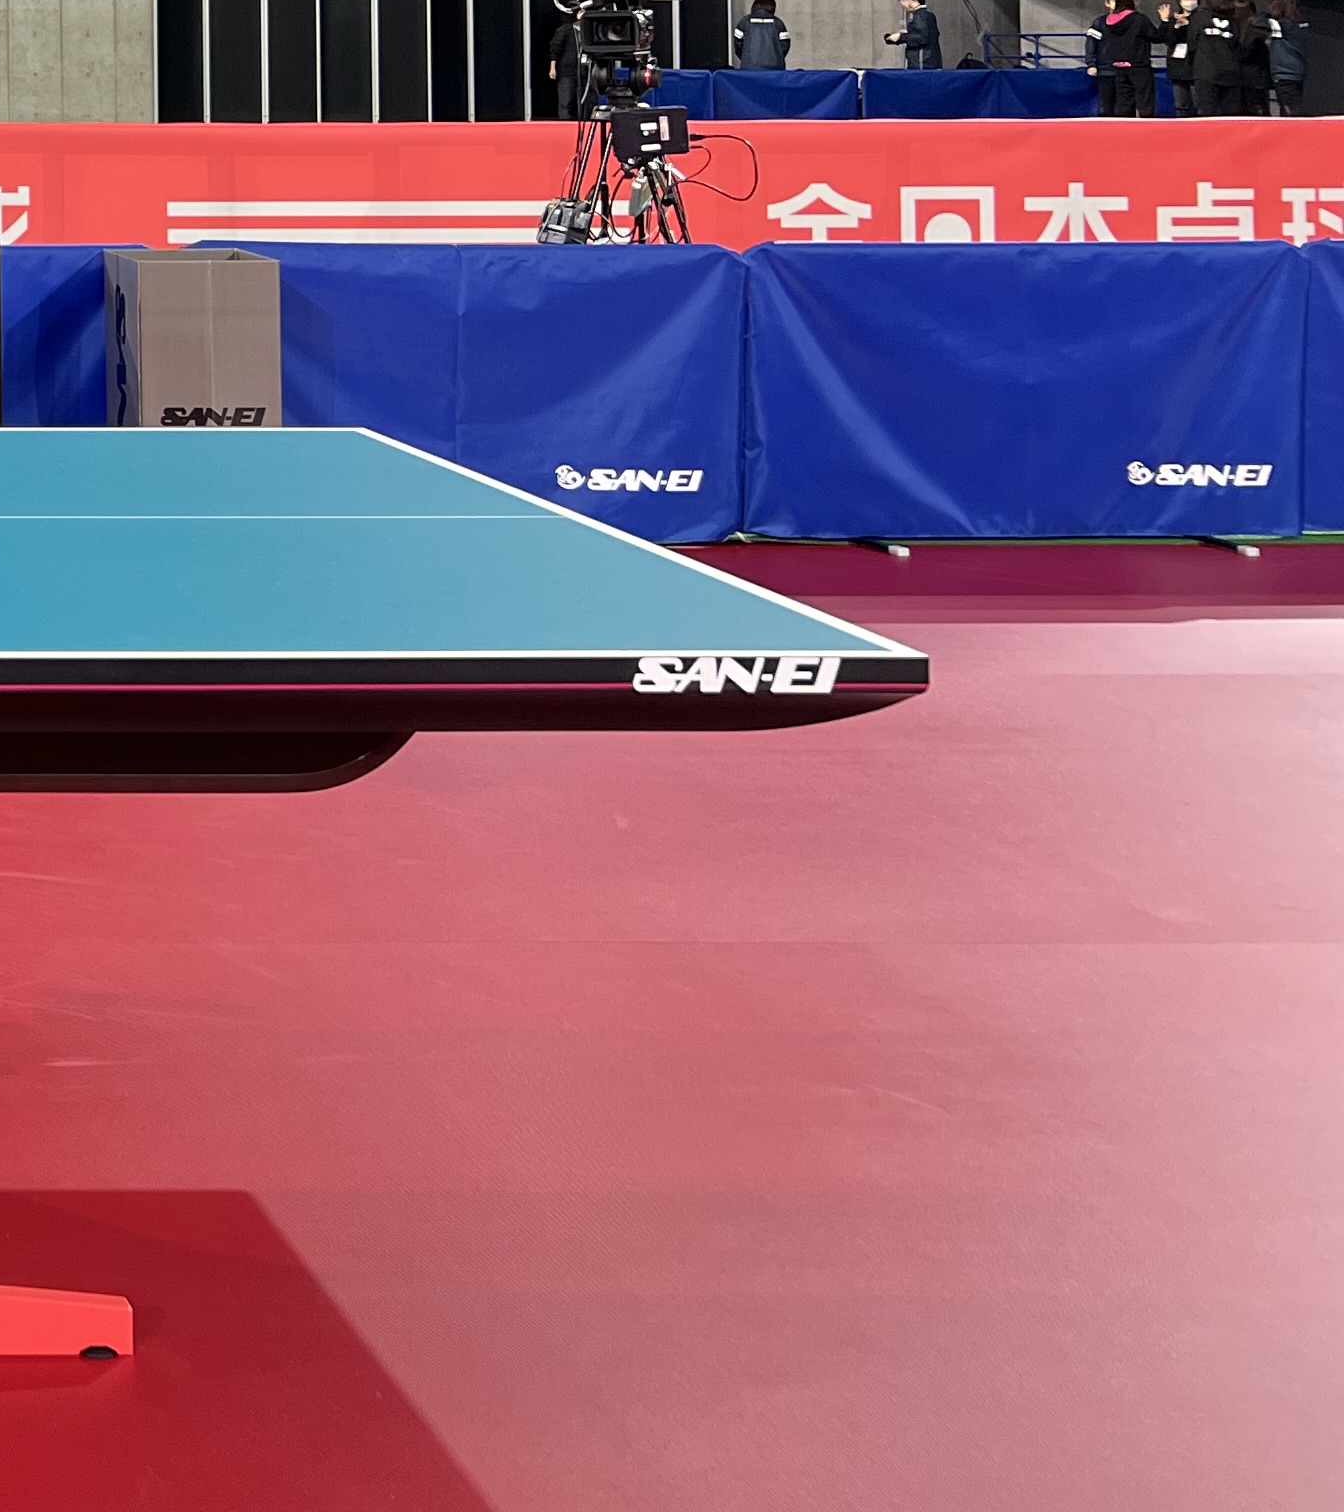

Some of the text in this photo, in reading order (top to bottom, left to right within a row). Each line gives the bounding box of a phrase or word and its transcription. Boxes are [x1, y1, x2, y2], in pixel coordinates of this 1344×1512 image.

[161, 407, 266, 427] SAN-EI
[587, 468, 704, 492] SAN-EI
[1155, 463, 1273, 486] SAN-EI
[632, 657, 841, 694] SAN-EI
